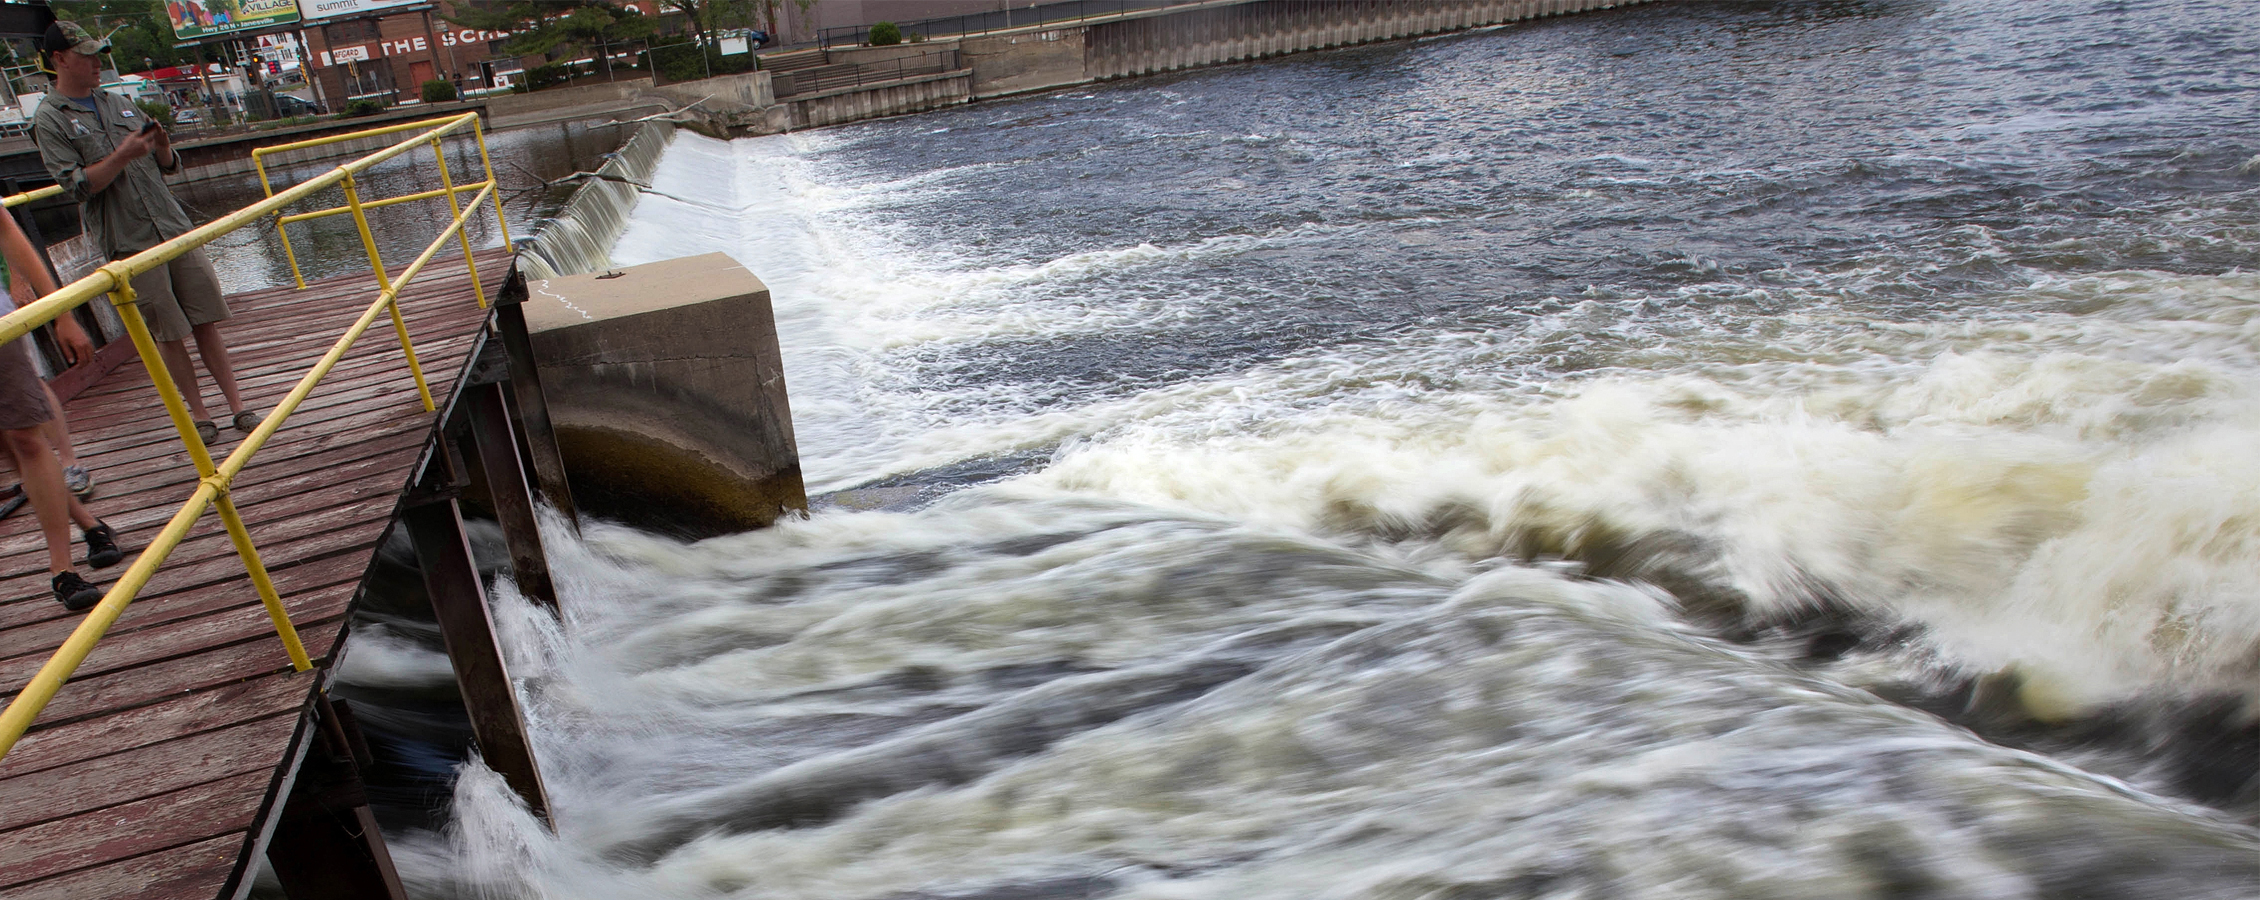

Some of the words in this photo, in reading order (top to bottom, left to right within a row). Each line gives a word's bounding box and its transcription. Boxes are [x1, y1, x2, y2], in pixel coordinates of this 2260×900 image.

[247, 0, 293, 11] VILLAGE
[316, 0, 359, 11] summit
[202, 26, 218, 34] Hwy
[241, 17, 275, 28] Janesville
[381, 36, 428, 56] THE
[334, 48, 360, 59] AFGARD
